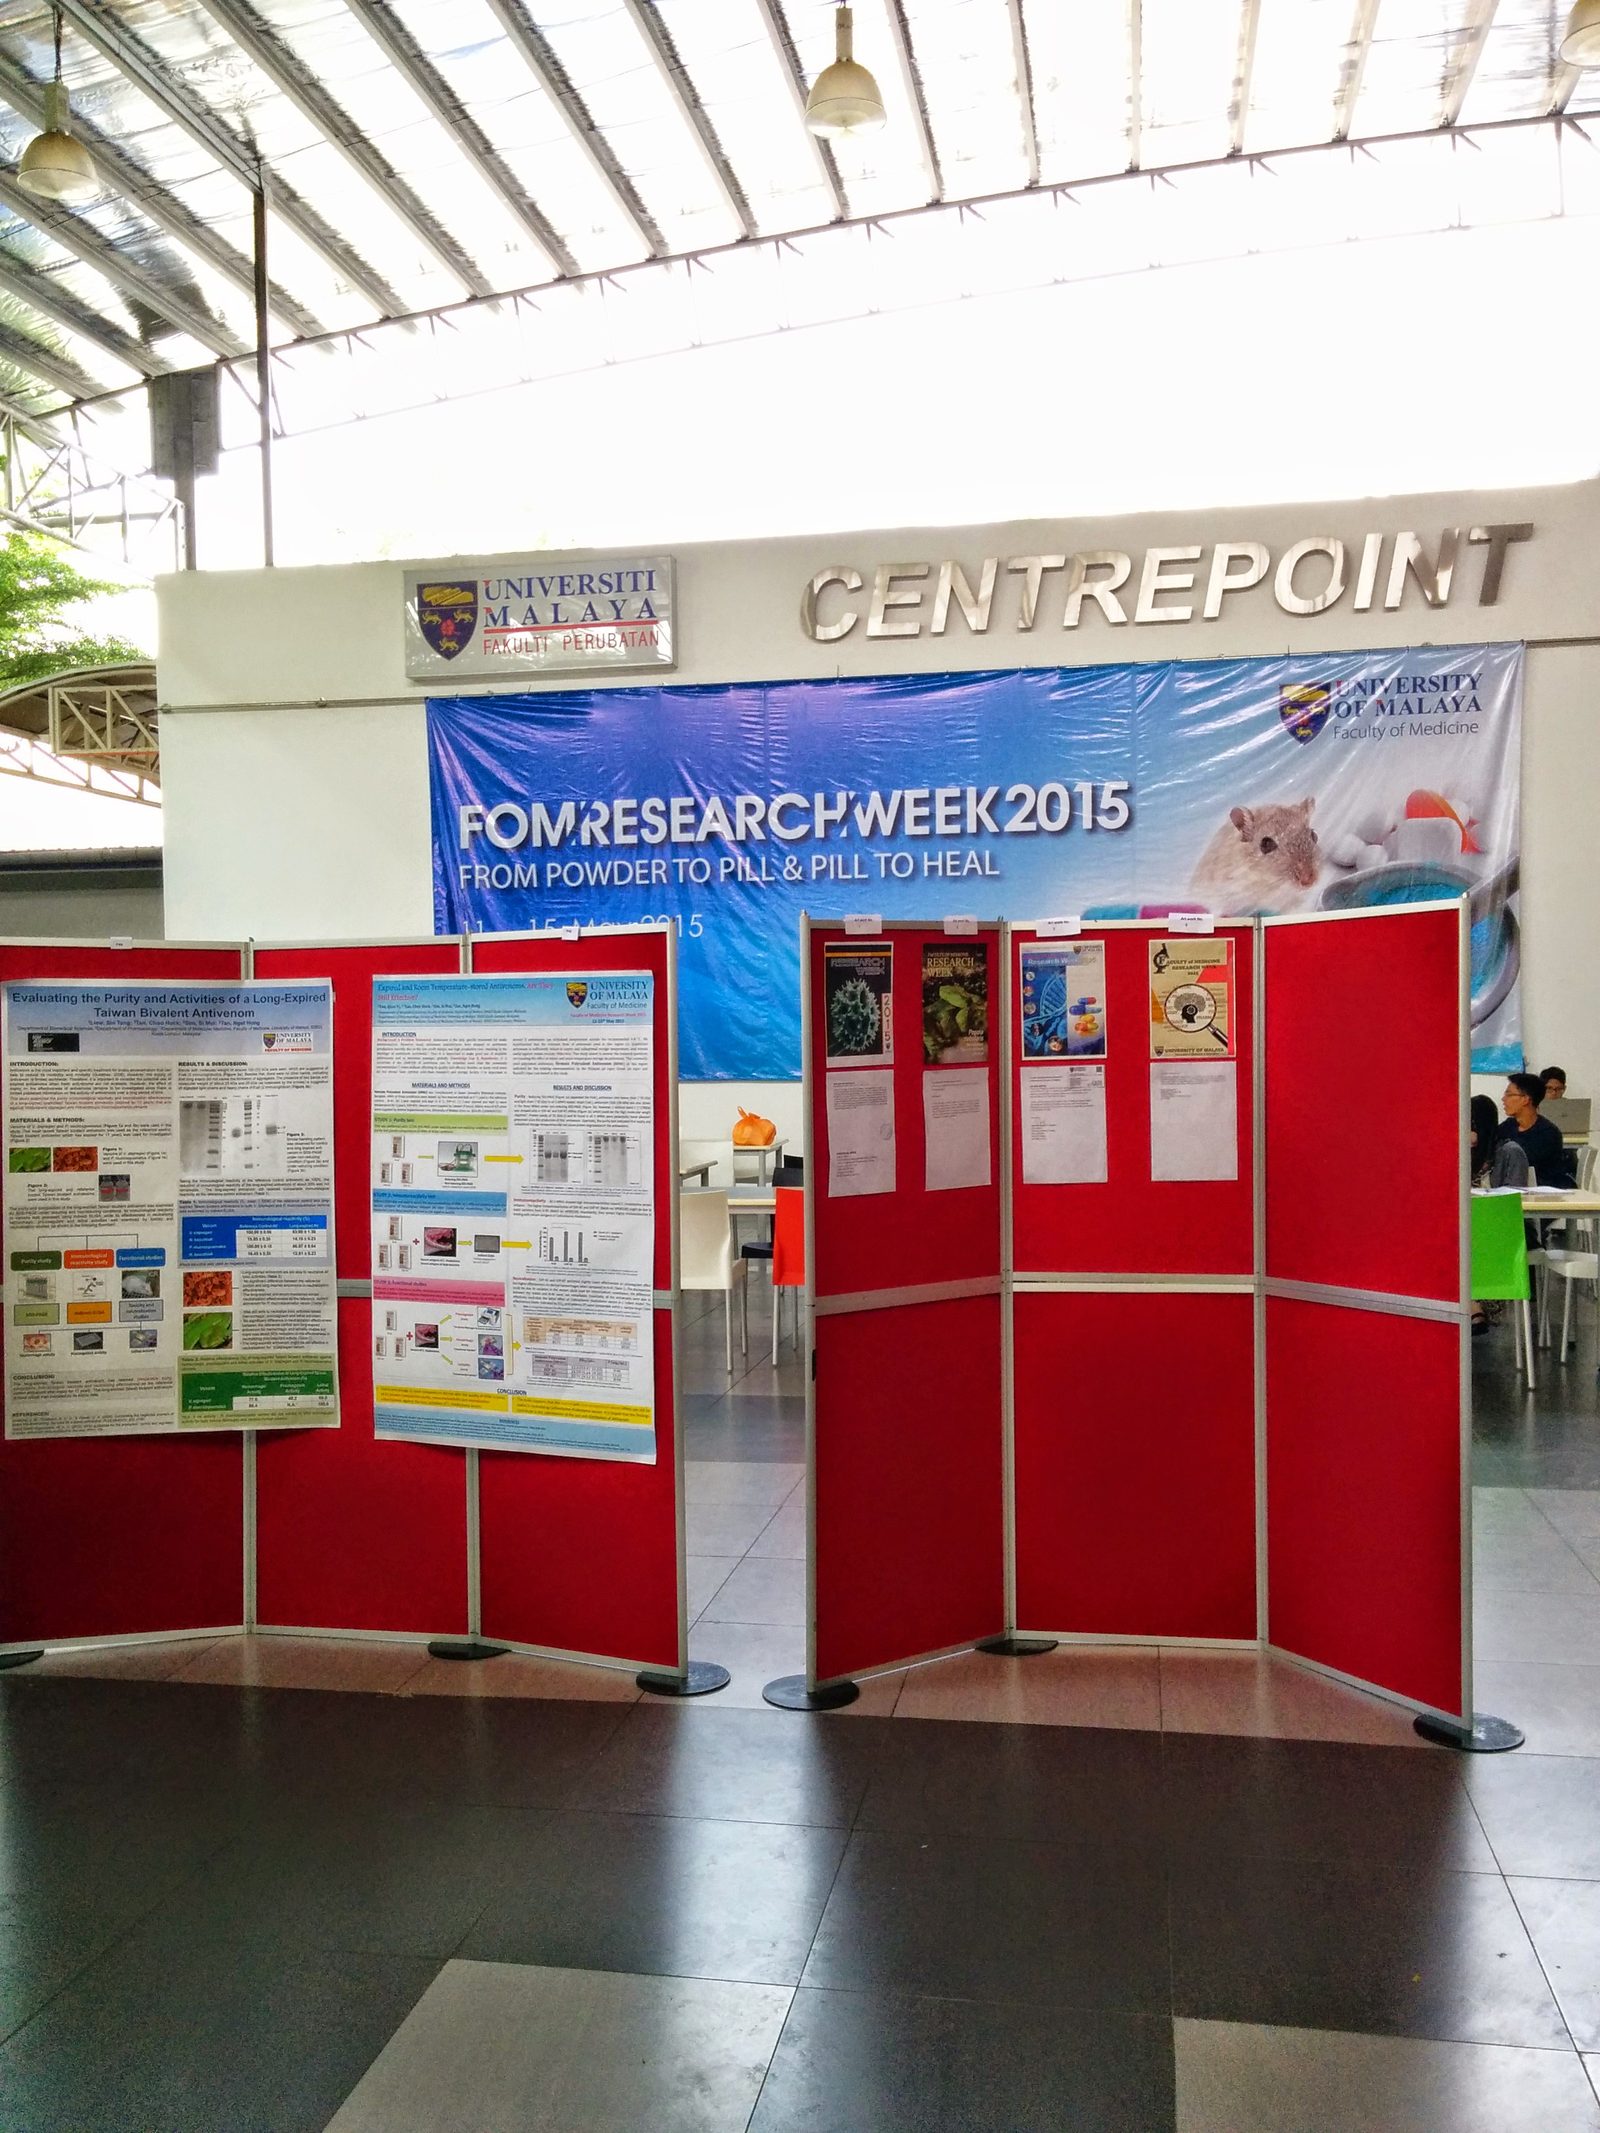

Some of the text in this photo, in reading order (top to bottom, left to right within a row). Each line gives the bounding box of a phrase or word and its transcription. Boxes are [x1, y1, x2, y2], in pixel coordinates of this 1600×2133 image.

[483, 569, 656, 601] UNIVERSITI
[800, 522, 1534, 642] CENTREPOINT
[484, 598, 657, 627] MALAYA
[483, 631, 659, 655] FAKULTI PERUBATAN
[1336, 673, 1483, 697] UNIVERSITY
[1335, 695, 1482, 718] OF MALAYA
[1334, 721, 1479, 741] Faculty of Medicine
[460, 850, 1000, 890] FROM POWDER TO PILL & PILL TO HEAL
[928, 957, 974, 967] RESEARCH
[928, 968, 953, 977] WEEK
[590, 980, 648, 990] UNIVERSITY
[590, 991, 648, 1000] OF MALAYA
[12, 992, 78, 1005] Evaluating
[82, 993, 100, 1003] the
[104, 993, 140, 1005] Purity
[144, 993, 166, 1004] and
[169, 993, 227, 1004] Activities
[229, 994, 241, 1004] of
[253, 992, 326, 1006] Long-Expired
[94, 1008, 255, 1018] Taiwan Bivalent Antivenom
